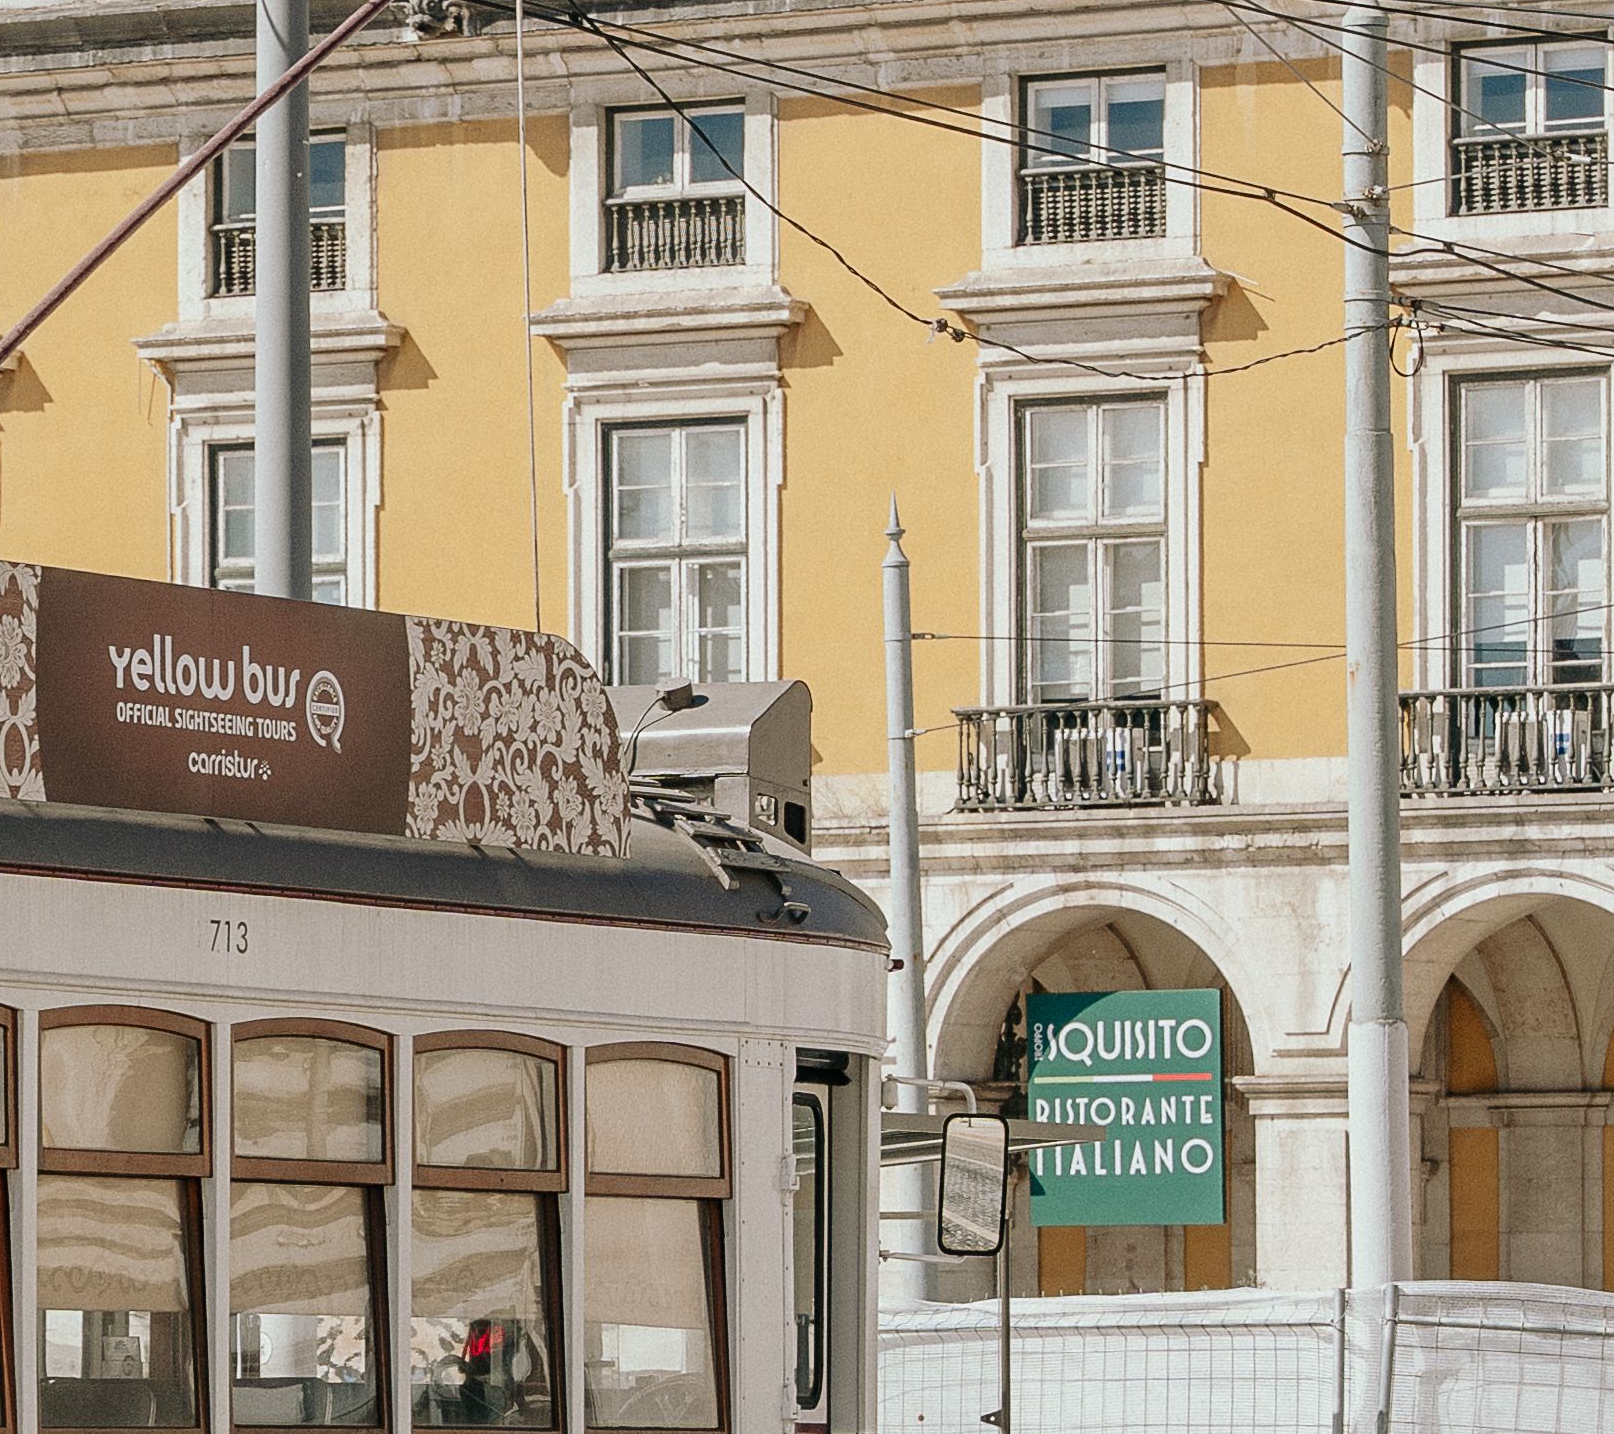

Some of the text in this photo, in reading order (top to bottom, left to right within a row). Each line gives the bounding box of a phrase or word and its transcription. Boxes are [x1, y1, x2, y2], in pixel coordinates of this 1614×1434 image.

[108, 633, 301, 709] yellow bus
[116, 700, 297, 742] OFFICIAL SIGHTSEEING TOURS
[188, 748, 259, 779] carristur
[210, 919, 249, 954] 713
[1047, 1018, 1213, 1067] SQUISITO
[1035, 1094, 1214, 1126] RISTORANTE
